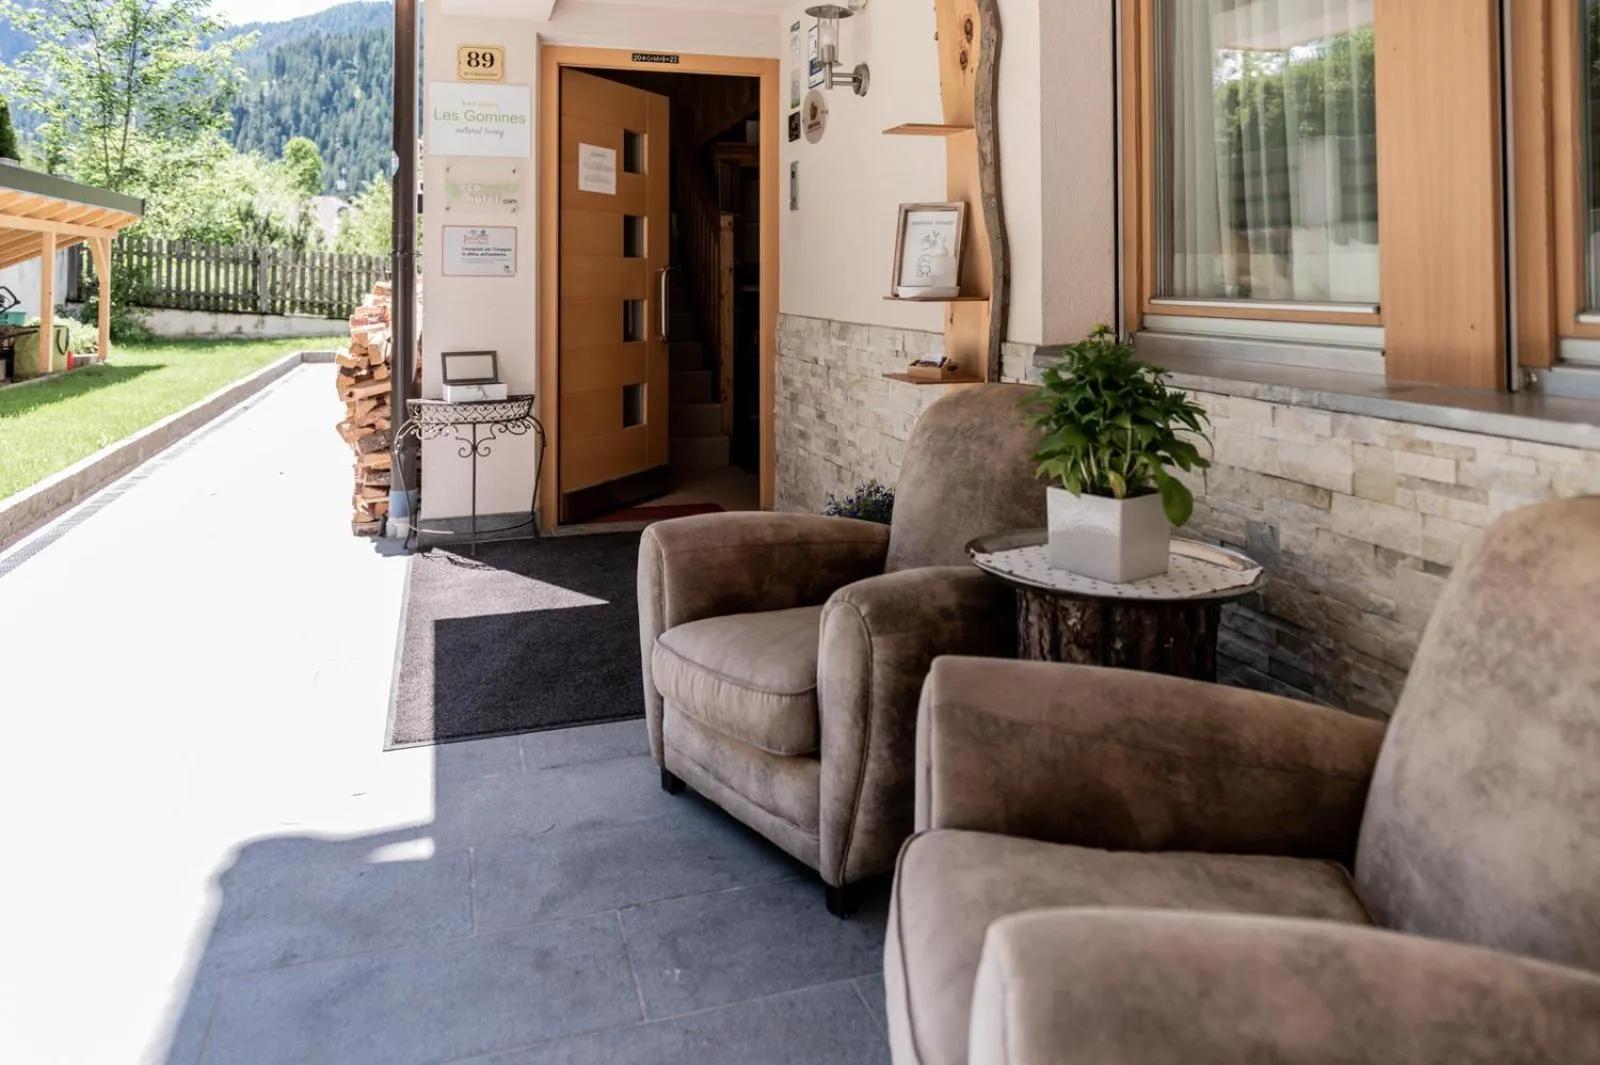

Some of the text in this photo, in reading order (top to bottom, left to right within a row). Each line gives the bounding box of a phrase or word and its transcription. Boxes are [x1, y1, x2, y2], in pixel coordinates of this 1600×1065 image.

[467, 51, 495, 69] 89
[434, 107, 526, 125] Les Gomines
